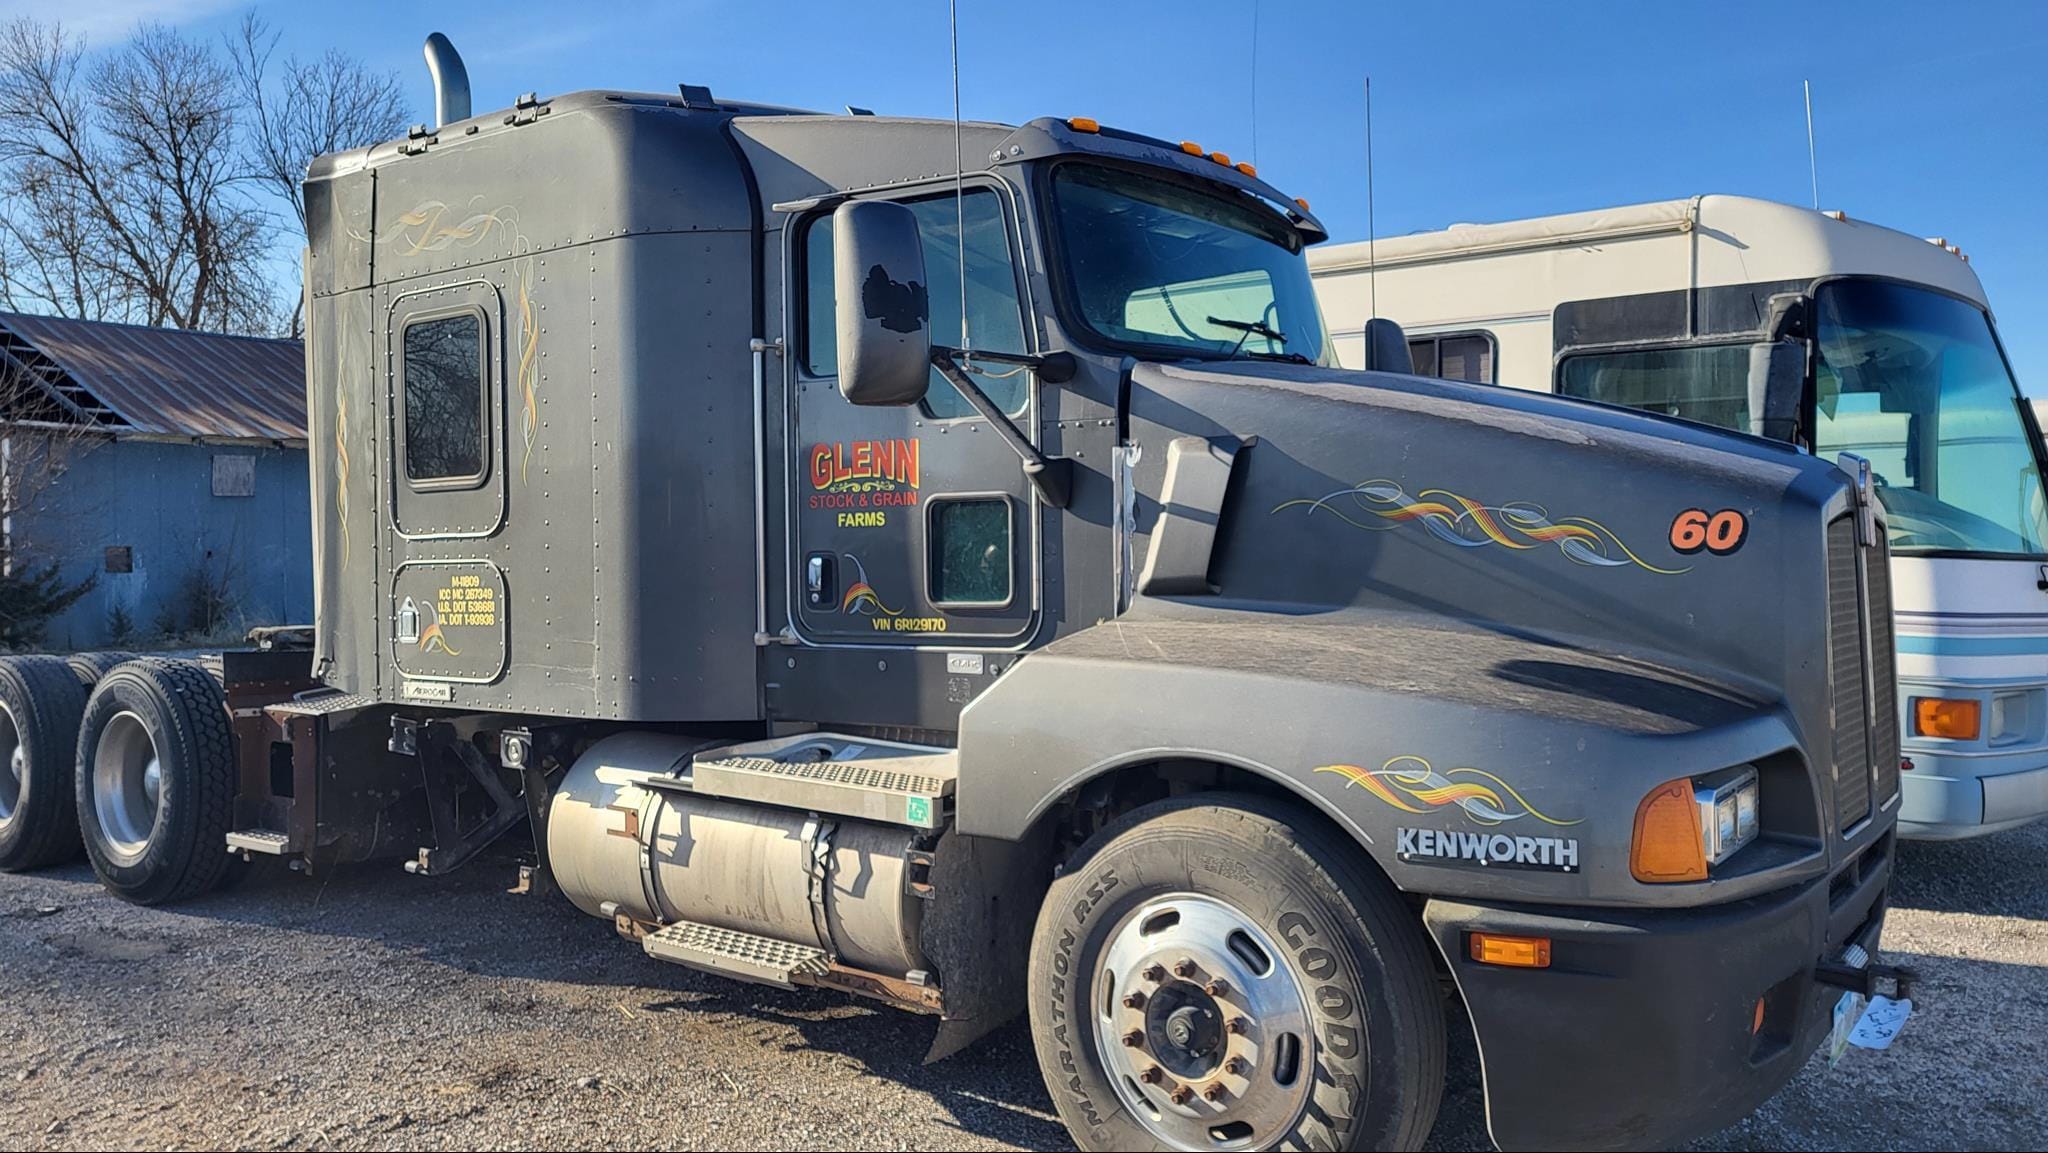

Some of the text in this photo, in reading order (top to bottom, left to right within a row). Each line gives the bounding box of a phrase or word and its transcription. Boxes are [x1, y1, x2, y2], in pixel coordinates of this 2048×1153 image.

[810, 438, 920, 490] GLENN
[810, 490, 918, 509] STOCK & GRAIN
[838, 511, 886, 527] FARMS
[1668, 507, 1749, 556] 60
[438, 588, 451, 600] ICC
[452, 588, 464, 600] MC
[453, 600, 467, 613] DOT
[449, 613, 463, 626] DOT
[871, 617, 947, 632] VIN 6R129170
[1396, 827, 1579, 867] KENWORTH
[1051, 869, 1119, 1126] MARATHON RSS
